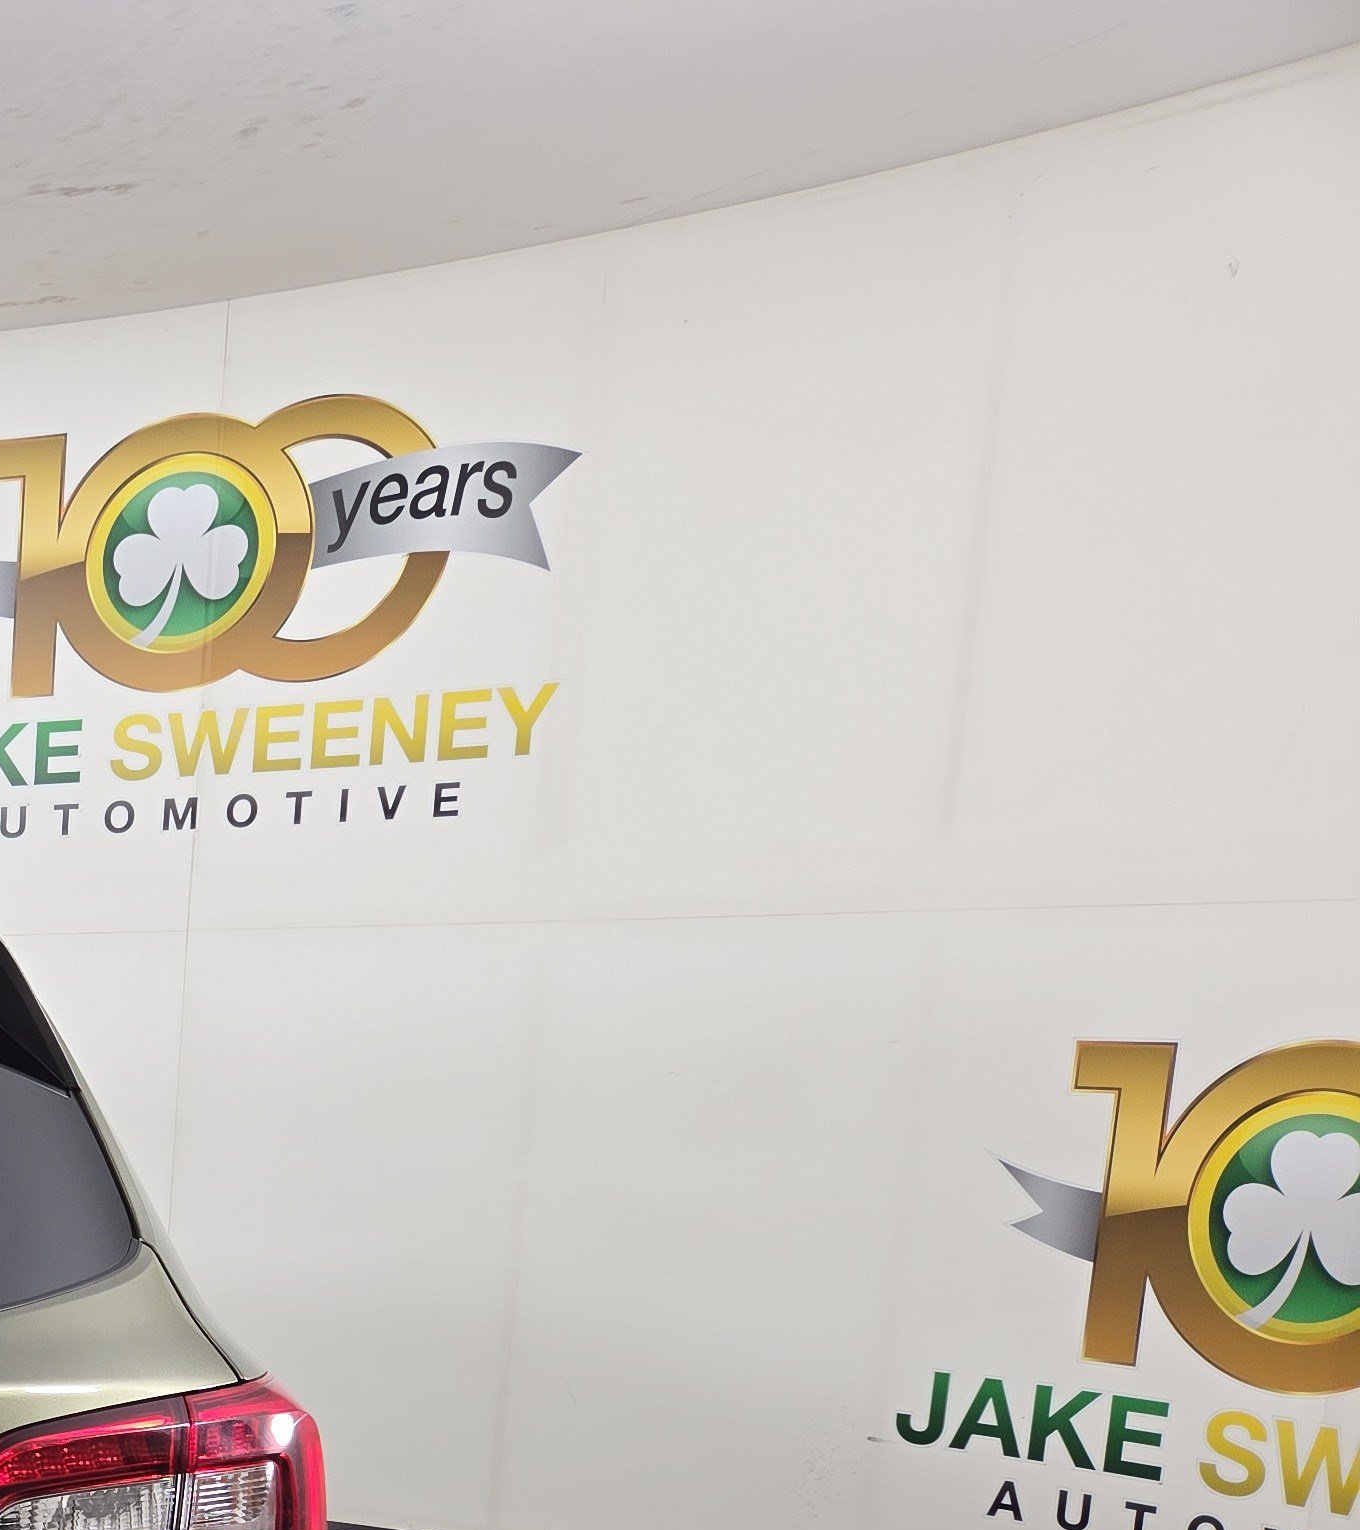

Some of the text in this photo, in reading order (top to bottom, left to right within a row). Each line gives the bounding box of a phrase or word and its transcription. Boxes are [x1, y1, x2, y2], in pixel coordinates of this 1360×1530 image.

[326, 459, 518, 554] years
[109, 682, 560, 782] SWEENEY
[895, 1370, 1170, 1483] JAKE
